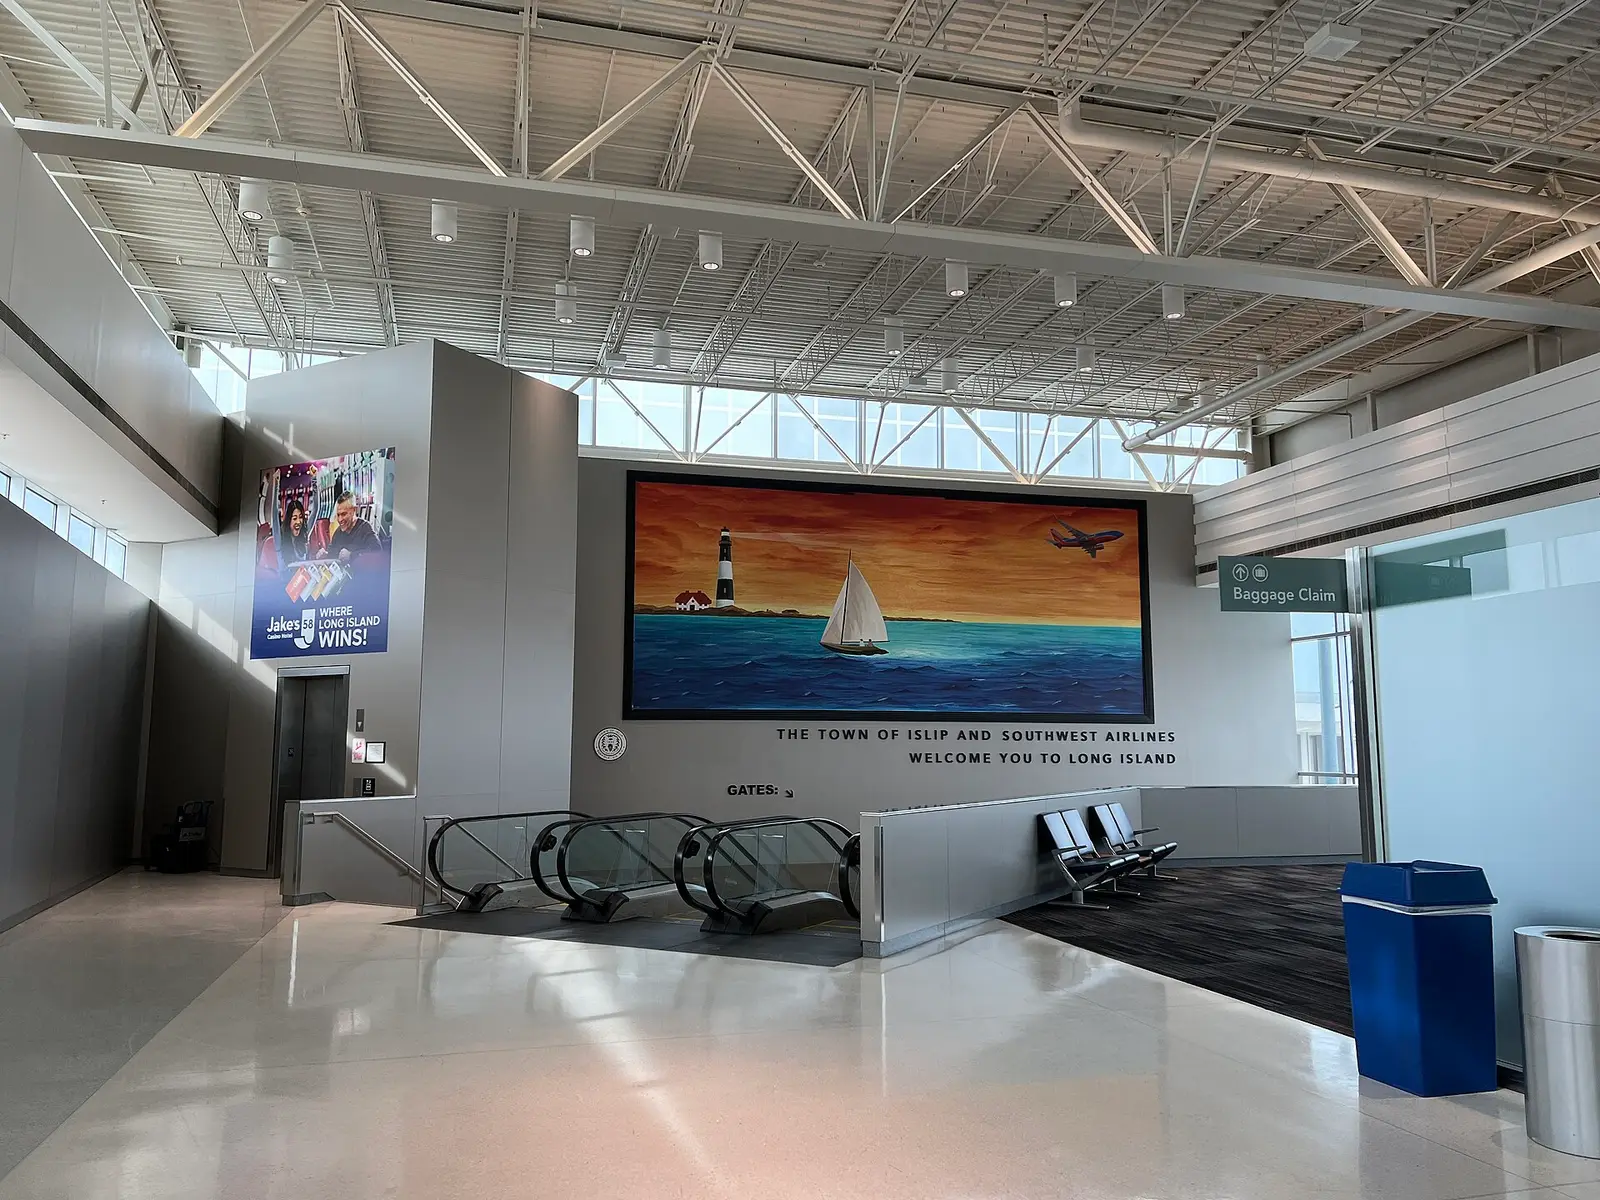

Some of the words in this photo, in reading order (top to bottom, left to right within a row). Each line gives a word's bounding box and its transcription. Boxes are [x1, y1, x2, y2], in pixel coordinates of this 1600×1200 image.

[1233, 587, 1294, 604] Baggage
[1298, 588, 1336, 602] Claim
[320, 606, 352, 617] WHERE
[266, 616, 300, 632] Jake's
[303, 619, 313, 629] 58
[319, 619, 344, 629] LONG
[346, 615, 380, 627] ISLAND
[318, 628, 367, 648] WINS!
[776, 729, 809, 740] THE
[818, 729, 869, 740] TOWN
[877, 729, 899, 740] OF
[908, 729, 949, 741] ISLIP
[956, 730, 992, 741] AND
[1001, 730, 1098, 742] SOUTHWEST
[1105, 731, 1176, 742] AIRLINES
[909, 752, 992, 764] WELCOME
[999, 752, 1032, 764] YOU
[1040, 753, 1061, 764] TO
[1069, 753, 1112, 764] LONG
[1120, 753, 1176, 764] ISLAND
[727, 784, 779, 796] GATES:
